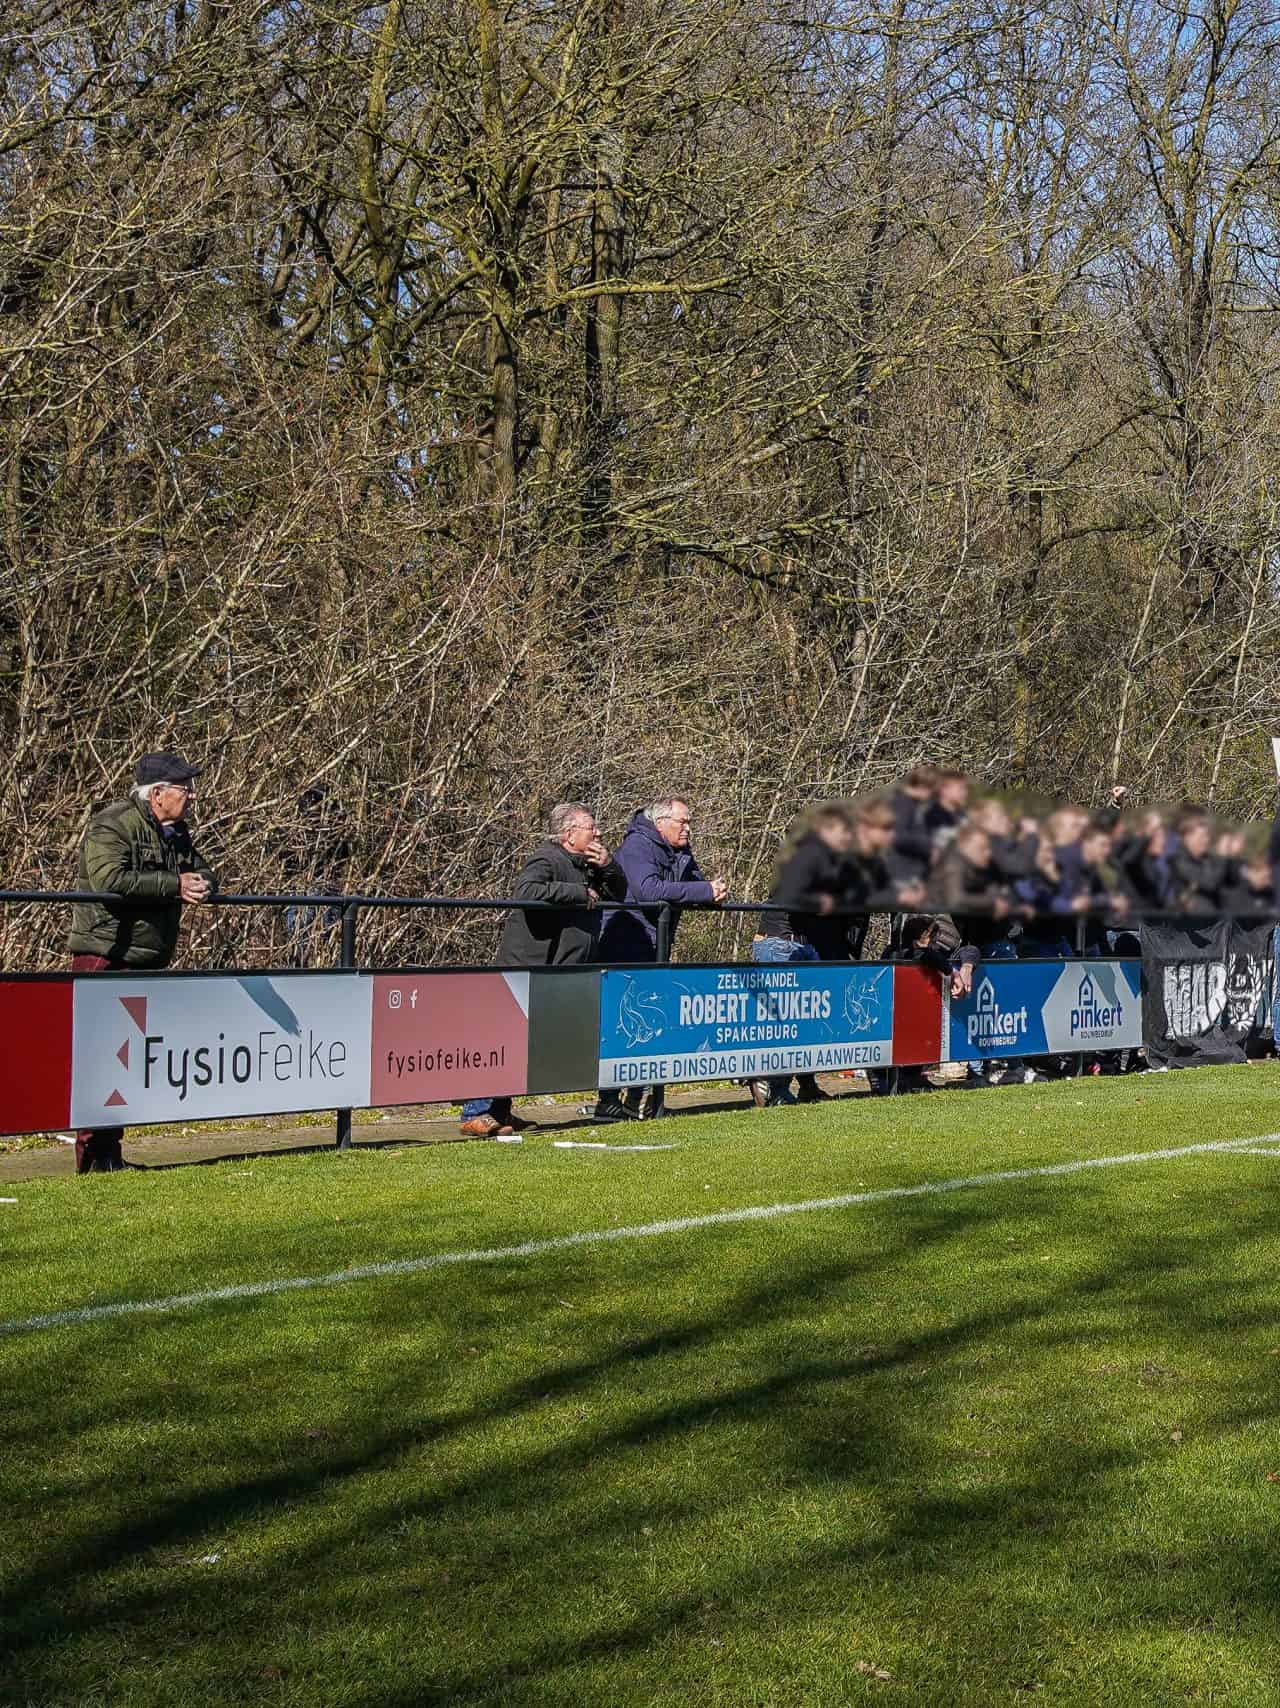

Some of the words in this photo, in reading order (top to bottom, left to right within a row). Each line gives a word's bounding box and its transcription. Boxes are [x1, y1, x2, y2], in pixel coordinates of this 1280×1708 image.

[717, 972, 799, 990] ZEEVISHANDEL
[679, 992, 749, 1026] ROBERT
[755, 990, 832, 1022] BEUKERS
[967, 1004, 1028, 1045] pinkert
[1070, 1000, 1123, 1037] pinkert
[716, 1023, 798, 1044] SPAKENBURG
[144, 1030, 347, 1101] FysioFeike
[386, 1045, 506, 1080] fysiofeike.nl
[613, 1060, 668, 1083] IEDERE
[672, 1055, 737, 1078] DINSDAG
[742, 1054, 756, 1073] IN
[761, 1050, 812, 1072] HOLTEN
[816, 1045, 881, 1068] AANWEZIG
